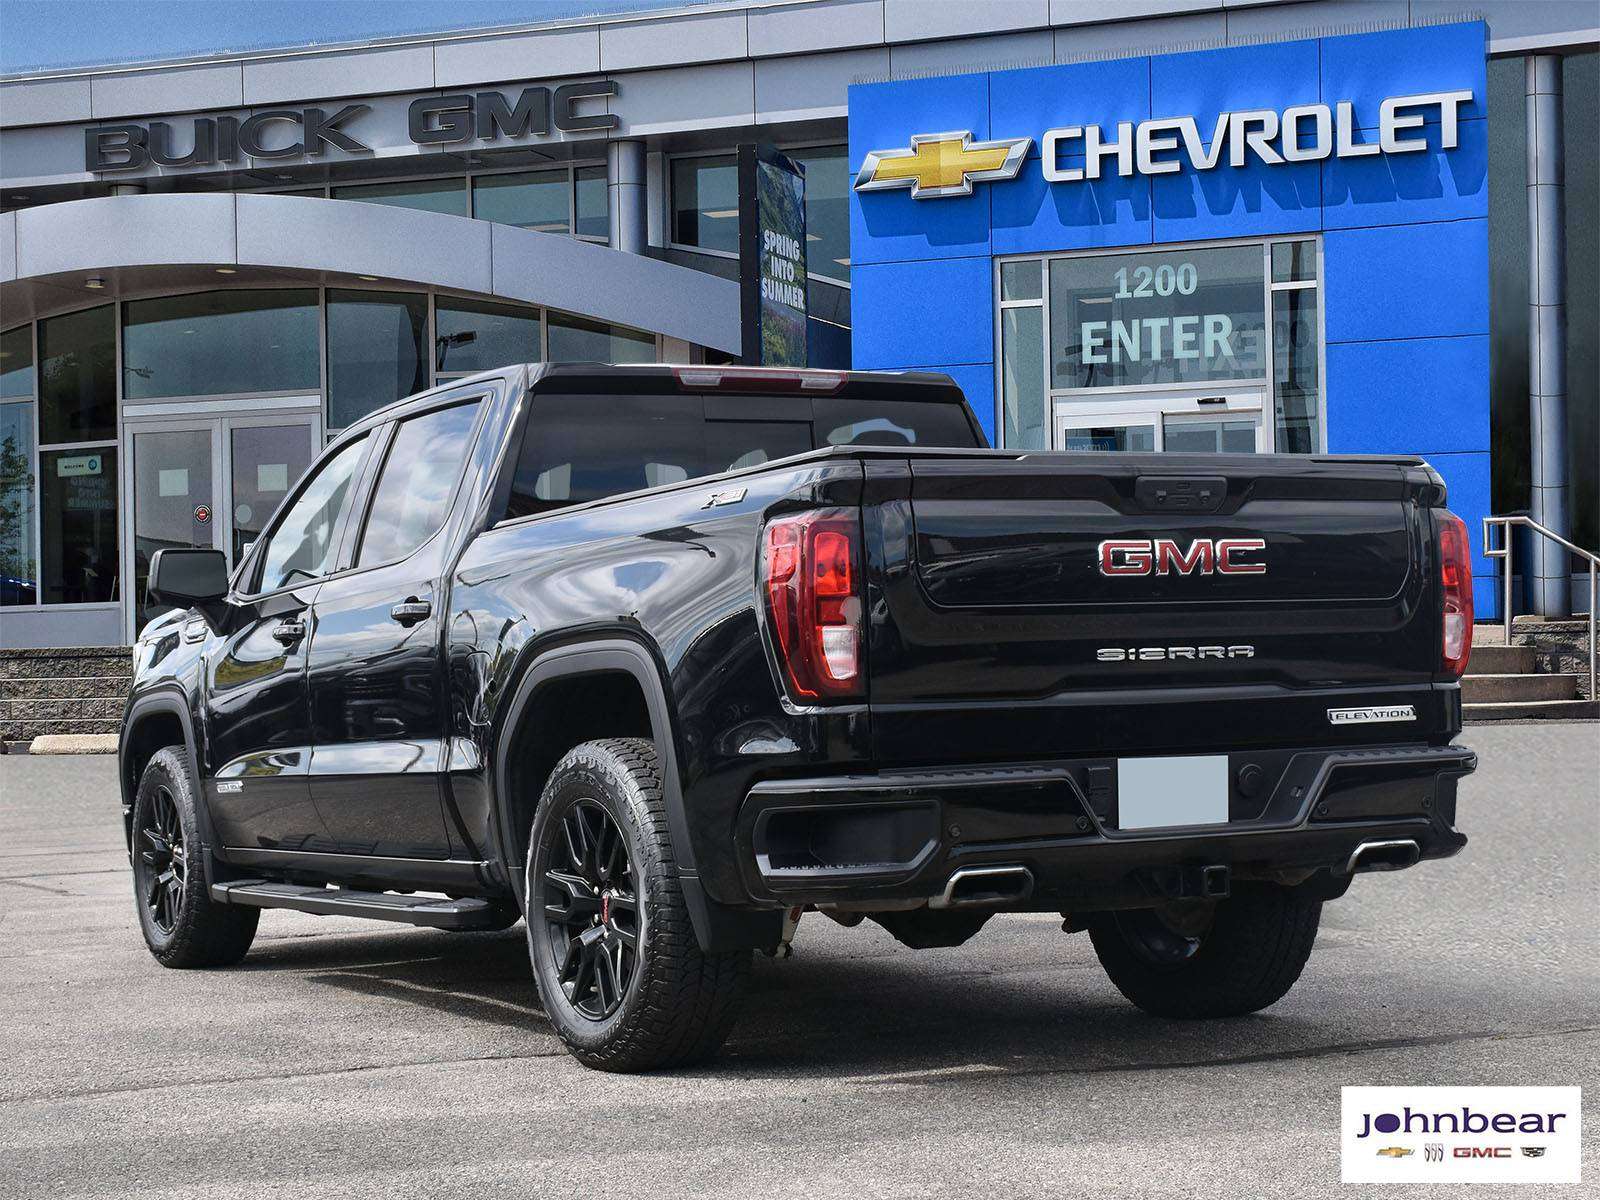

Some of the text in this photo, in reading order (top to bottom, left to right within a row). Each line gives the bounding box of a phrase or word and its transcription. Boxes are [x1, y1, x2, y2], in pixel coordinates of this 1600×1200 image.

[85, 80, 619, 172] BUICK GMC
[1042, 89, 1473, 183] CHEVROLET
[764, 229, 800, 261] SPRING
[771, 255, 795, 282] INTO
[1113, 263, 1198, 299] 1200
[762, 277, 804, 310] SUMMER
[1081, 314, 1235, 364] ENTER
[1098, 539, 1266, 576] GMC
[1097, 645, 1254, 661] SIERRA
[1336, 710, 1409, 720] ELEVATION
